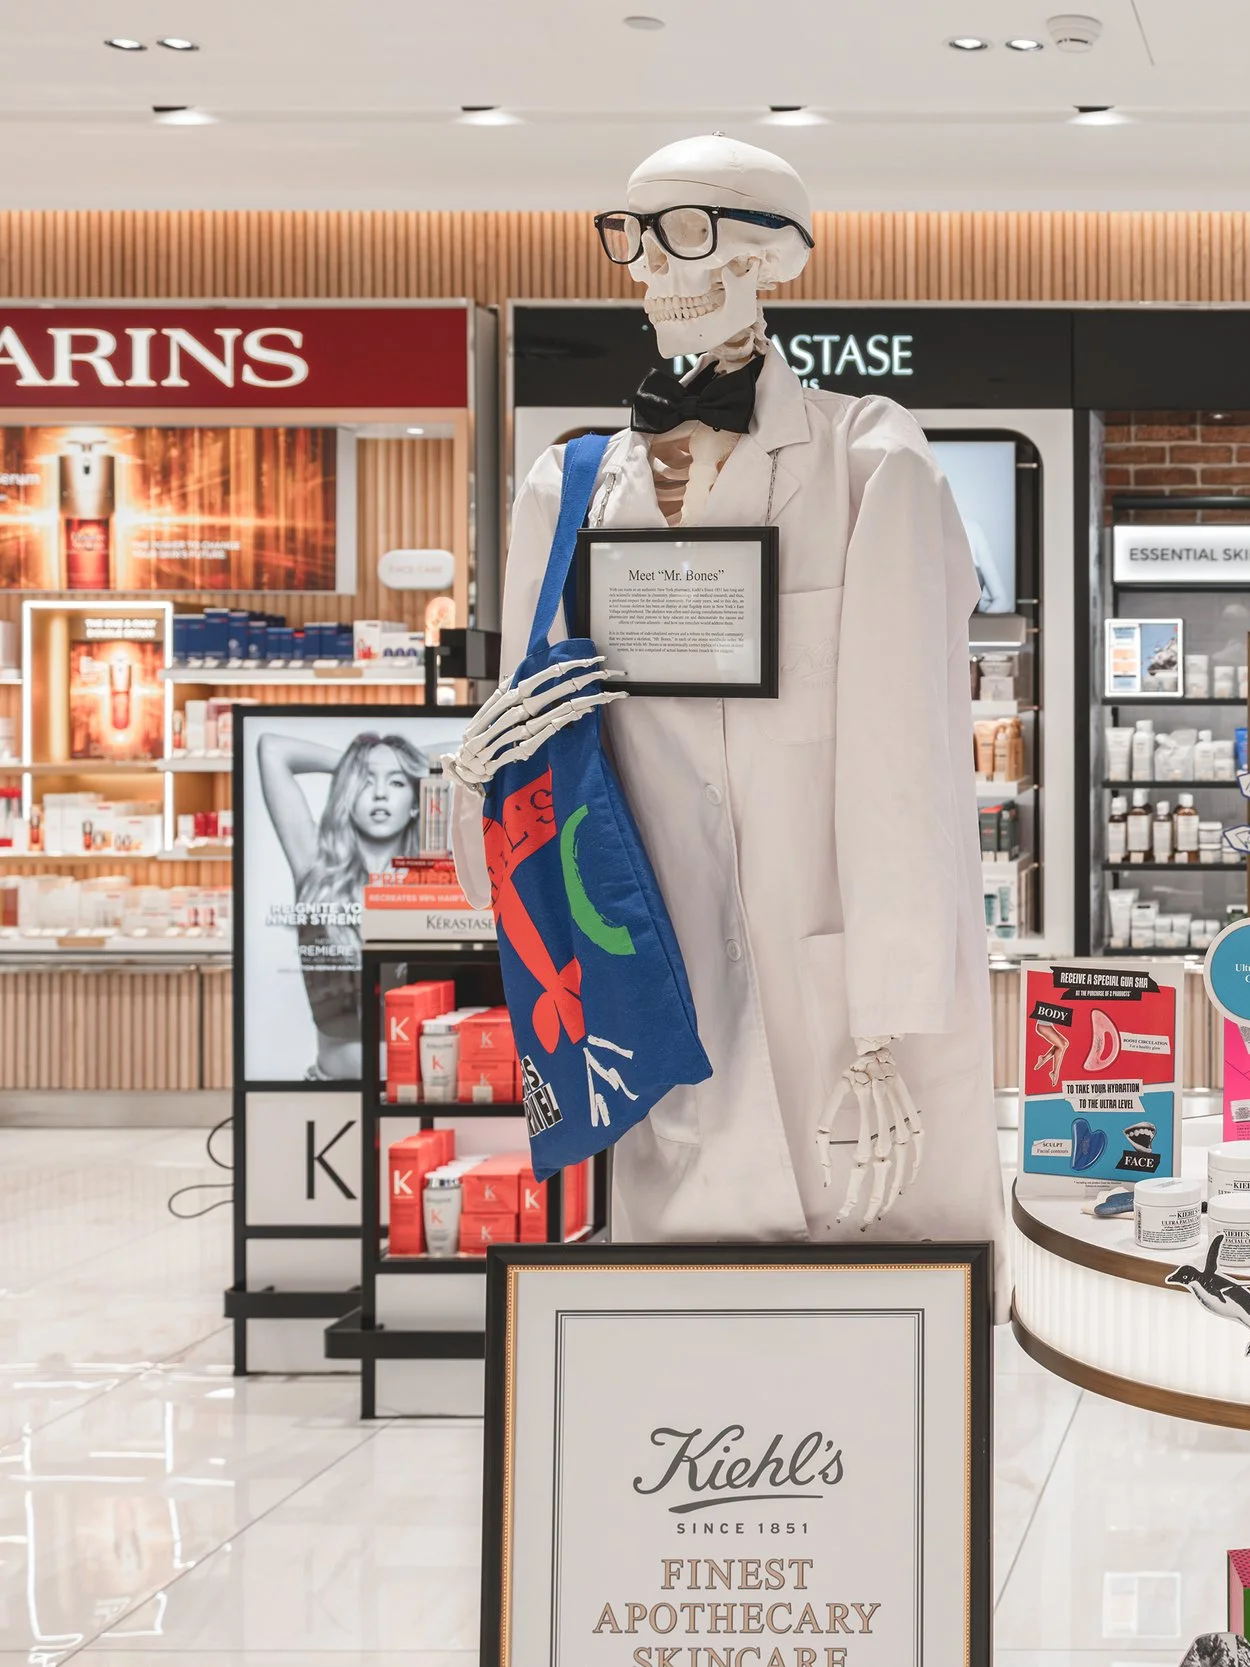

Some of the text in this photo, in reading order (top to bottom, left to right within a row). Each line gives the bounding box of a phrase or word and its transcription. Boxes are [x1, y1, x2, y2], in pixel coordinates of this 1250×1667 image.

[0, 326, 310, 388] ARINS
[1129, 547, 1218, 561] ESSENTIAL
[628, 569, 655, 581] Meet
[343, 902, 362, 914] YO
[310, 913, 362, 926] STREN
[426, 914, 495, 930] KÉRASTASE
[1060, 972, 1148, 989] RECEIVE A SPECIAL GUA SHA
[1037, 1005, 1069, 1021] BODY
[390, 1016, 410, 1041] K
[481, 1031, 493, 1046] K
[432, 1055, 444, 1070] K
[1066, 1083, 1140, 1094] TO TAKE YOUR HYDRATION
[1079, 1099, 1134, 1109] TO THE ULTRA LEVEL
[305, 1120, 357, 1200] K
[1124, 1156, 1155, 1168] FACE
[394, 1169, 413, 1195] K
[484, 1185, 496, 1200] K
[525, 1188, 541, 1210] K
[431, 1209, 443, 1225] K
[481, 1226, 493, 1241] K
[632, 1423, 845, 1495] Kiehl's
[676, 1523, 809, 1535] SINCE 1851
[660, 1558, 814, 1591] FINEST
[592, 1602, 881, 1634] APOTHECARY
[632, 1646, 849, 1667] SKINCARE
